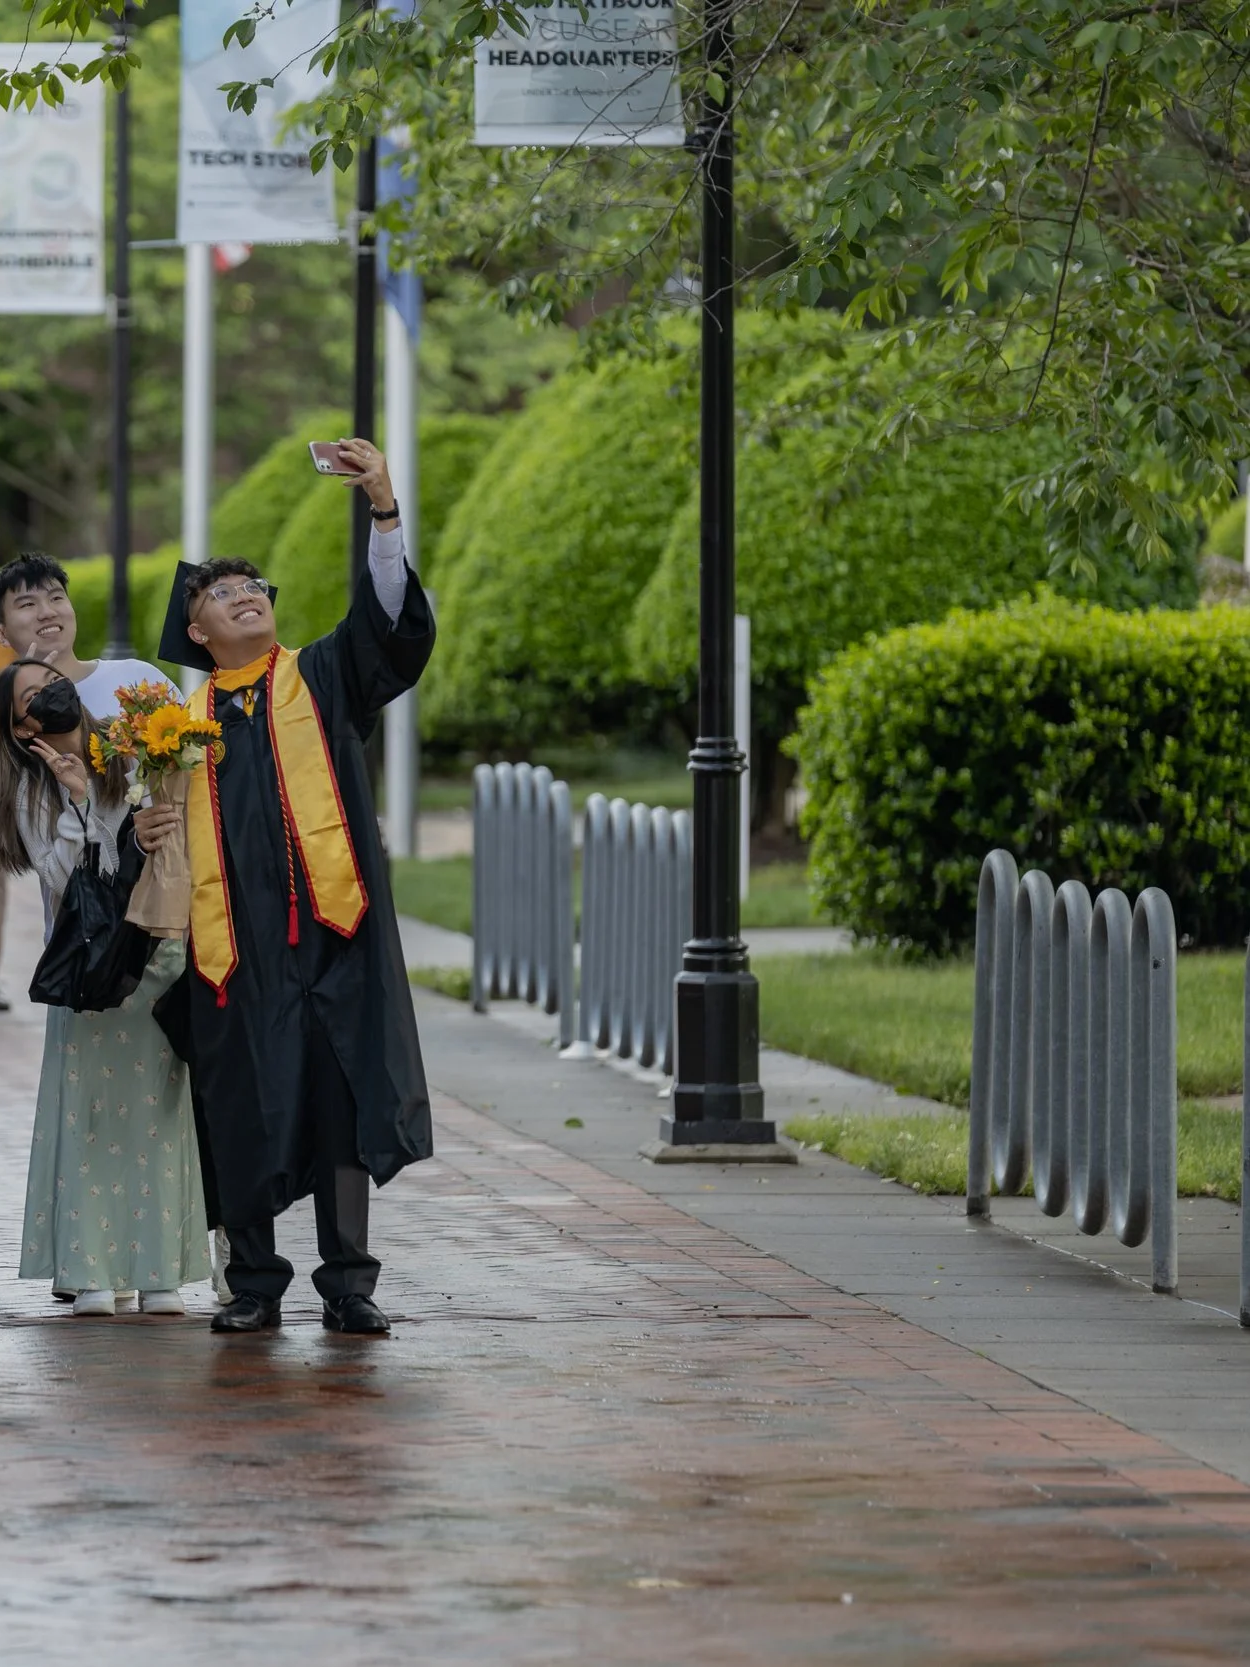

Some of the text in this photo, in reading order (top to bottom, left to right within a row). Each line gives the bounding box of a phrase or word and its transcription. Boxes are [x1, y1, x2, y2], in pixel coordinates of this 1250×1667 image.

[591, 19, 672, 40] GEAR
[488, 51, 673, 66] HEADQUARTERS
[189, 150, 312, 168] TECH STOR
